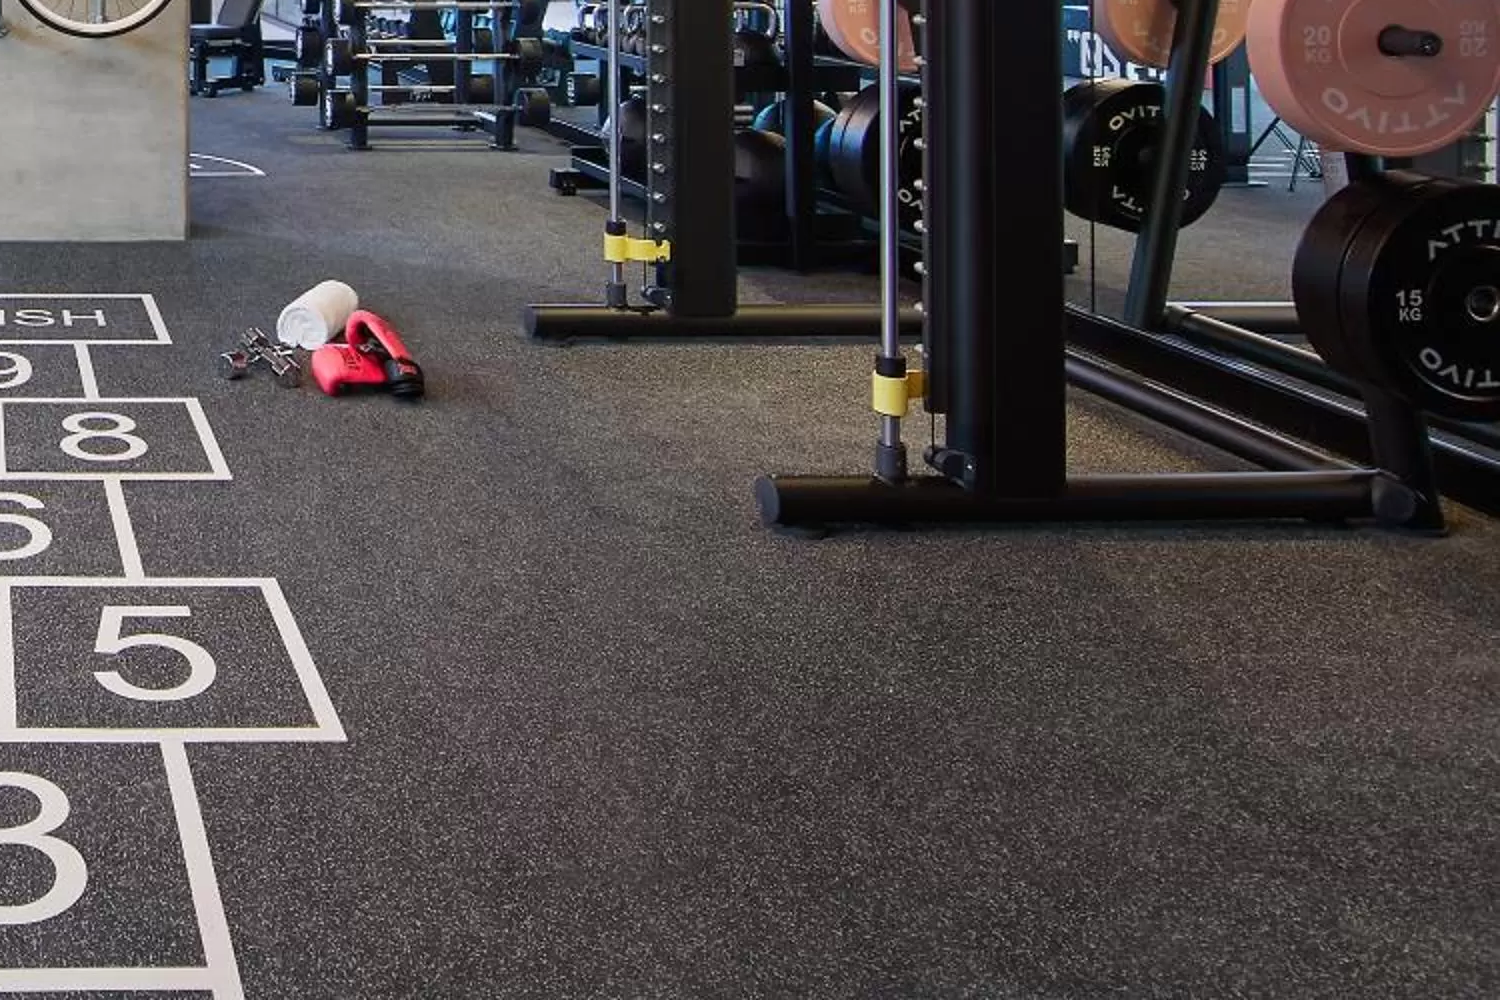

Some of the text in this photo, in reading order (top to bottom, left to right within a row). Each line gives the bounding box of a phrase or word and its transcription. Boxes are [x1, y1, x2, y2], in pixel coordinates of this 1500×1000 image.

[1304, 25, 1332, 46] 20
[1321, 80, 1466, 135] ATTIVO
[1427, 219, 1500, 262] ATTI
[1395, 289, 1424, 307] 15
[1399, 307, 1423, 322] KG
[1419, 347, 1500, 388] TIVO
[59, 411, 149, 462] 8
[92, 604, 218, 702] 5
